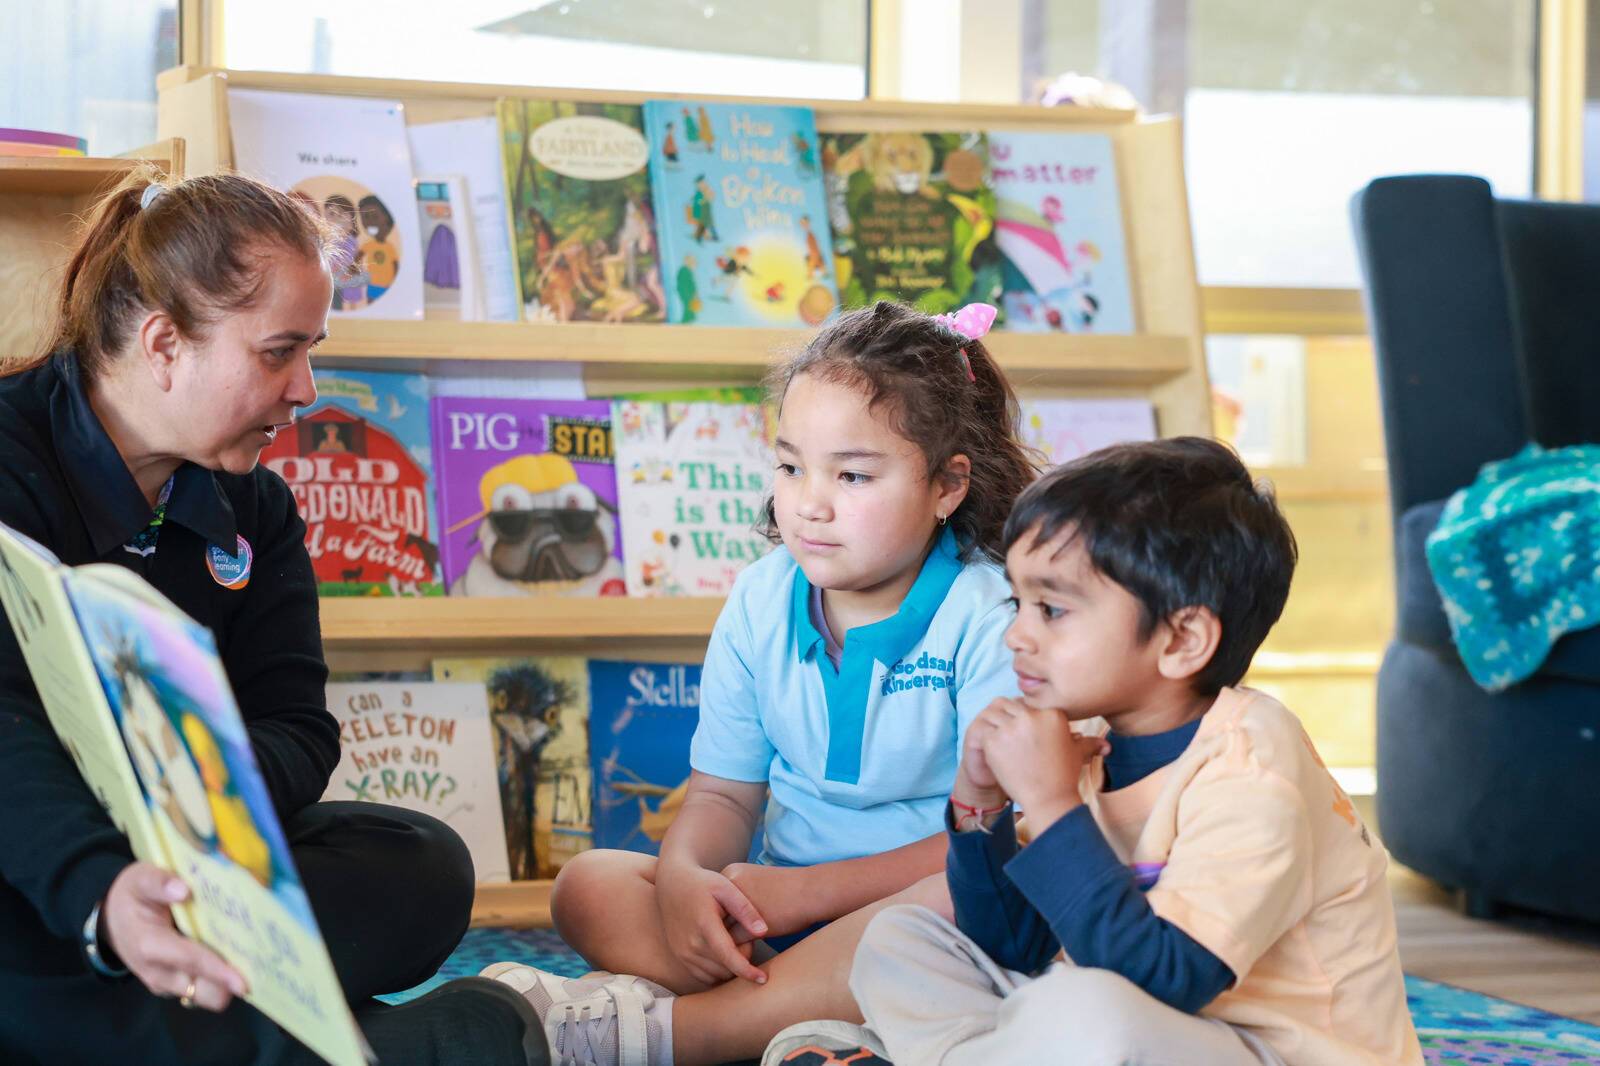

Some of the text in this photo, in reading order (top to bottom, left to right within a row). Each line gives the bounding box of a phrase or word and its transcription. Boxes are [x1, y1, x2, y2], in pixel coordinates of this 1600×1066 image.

[730, 111, 774, 137] How
[297, 152, 358, 167] We share
[990, 163, 1098, 185] matter
[448, 413, 518, 451] PIG
[264, 456, 400, 485] OLD
[679, 462, 763, 491] This
[292, 483, 425, 537] CDONALD
[675, 496, 704, 523] is
[326, 536, 342, 552] a
[343, 523, 425, 580] Farm
[402, 691, 413, 707] a
[626, 664, 702, 708] Stella
[340, 713, 456, 747] KELETON
[350, 745, 439, 773] have an
[344, 768, 459, 806] X-RAY?
